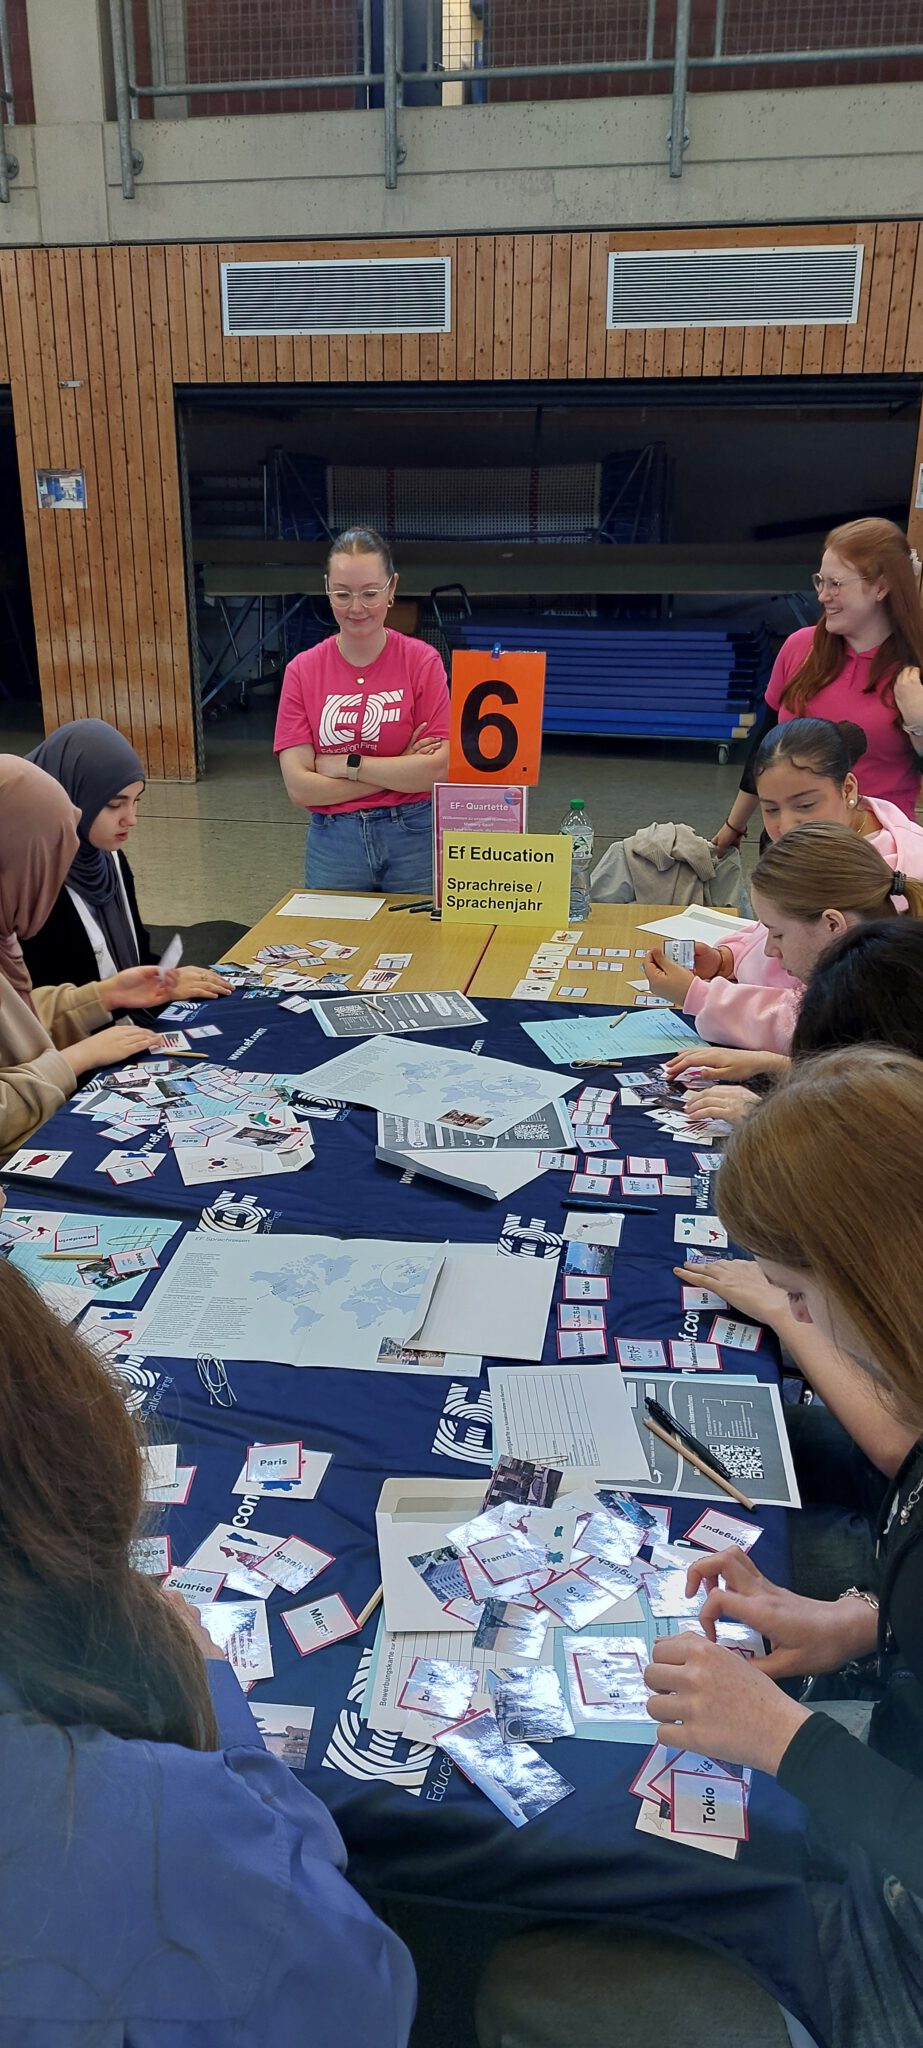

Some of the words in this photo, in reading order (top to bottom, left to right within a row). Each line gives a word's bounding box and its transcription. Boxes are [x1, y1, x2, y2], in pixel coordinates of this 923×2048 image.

[318, 689, 404, 747] EF
[466, 802, 509, 811] Quartette
[448, 846, 465, 859] Ef
[470, 847, 554, 863] Education
[447, 877, 533, 893] Sprachreise
[537, 881, 542, 893] /
[446, 895, 543, 913] Sprachenjahr
[227, 1027, 268, 1060] www.ef.com
[582, 1280, 591, 1295] Tokio
[701, 1292, 709, 1304] Rom
[259, 1458, 288, 1467] Paris
[701, 1523, 746, 1547] Singapur
[598, 1558, 639, 1584] Englisch
[168, 1579, 213, 1593] Sunrise
[379, 1651, 395, 1706] Bewerbungskarte
[702, 1787, 716, 1823] Tokio
